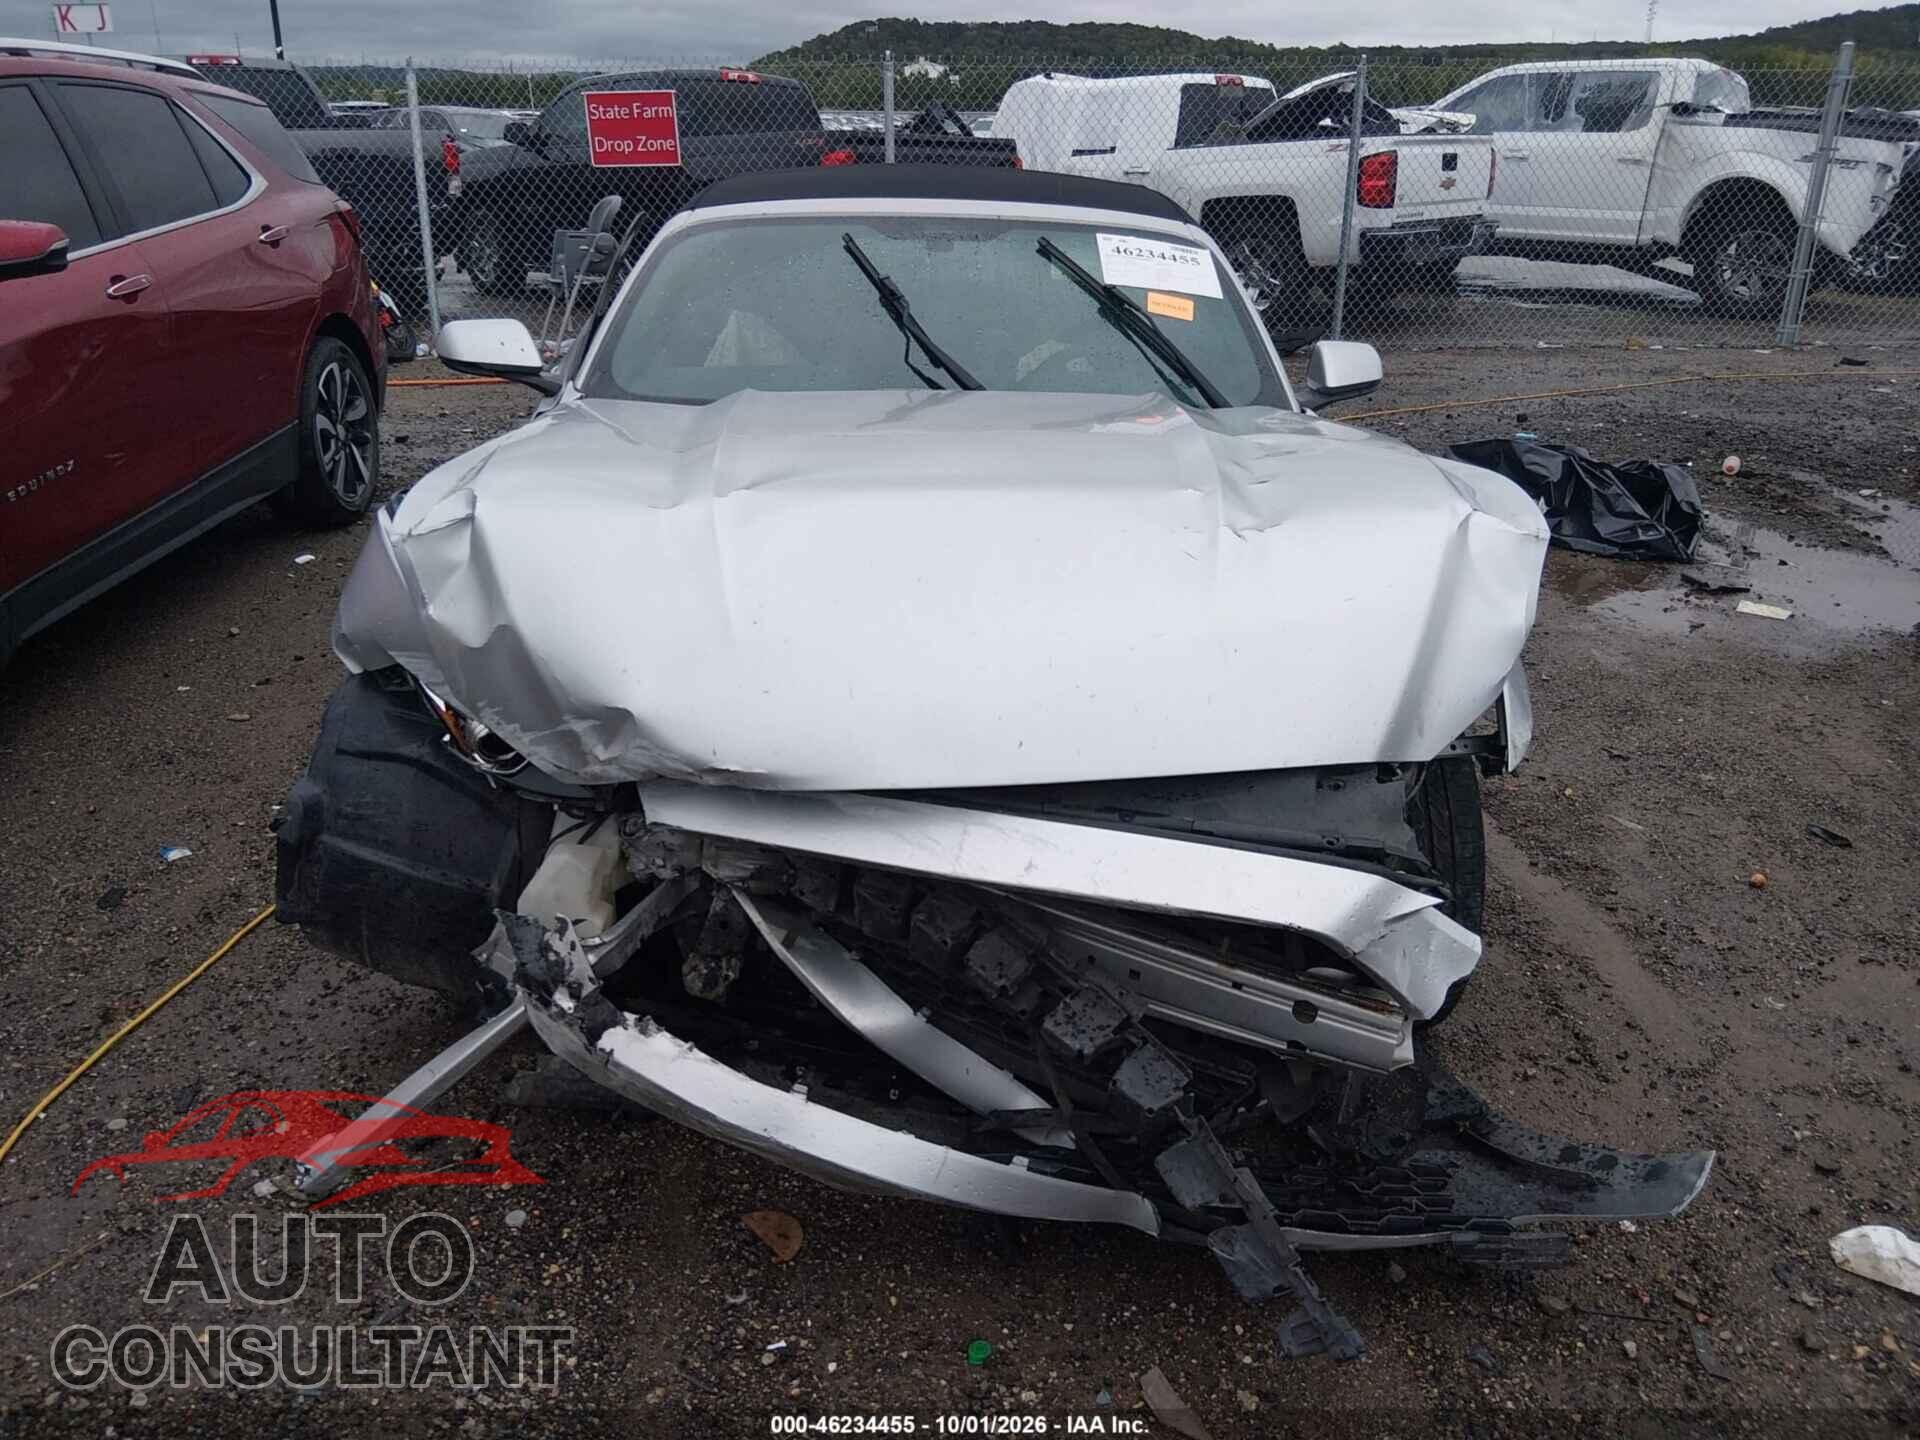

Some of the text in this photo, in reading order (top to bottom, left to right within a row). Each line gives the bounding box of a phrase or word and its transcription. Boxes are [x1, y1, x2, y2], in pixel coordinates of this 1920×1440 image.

[57, 5, 106, 31] K J
[589, 102, 673, 120] State Farm
[594, 135, 676, 155] Drop Zone
[1112, 246, 1201, 266] 46234455
